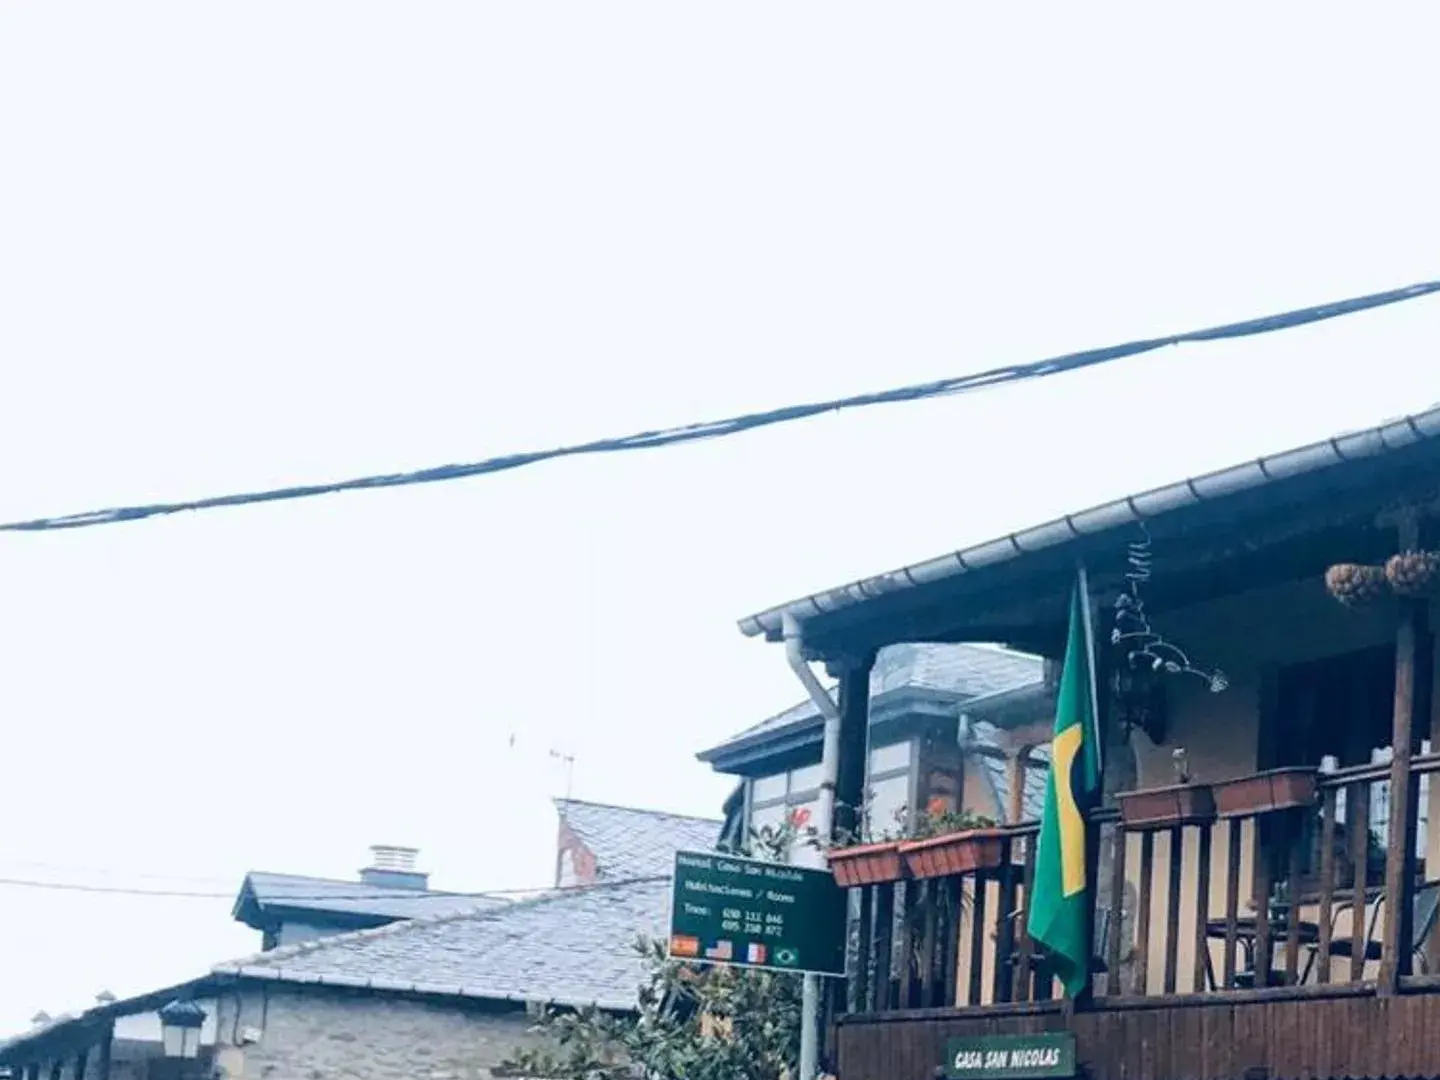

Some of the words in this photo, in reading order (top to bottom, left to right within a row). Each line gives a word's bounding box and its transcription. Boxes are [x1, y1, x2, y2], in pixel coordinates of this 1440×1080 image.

[744, 864, 763, 876] San
[954, 1051, 982, 1070] CASA
[984, 1050, 1008, 1069] SAN
[1009, 1047, 1061, 1069] NICOLAS
